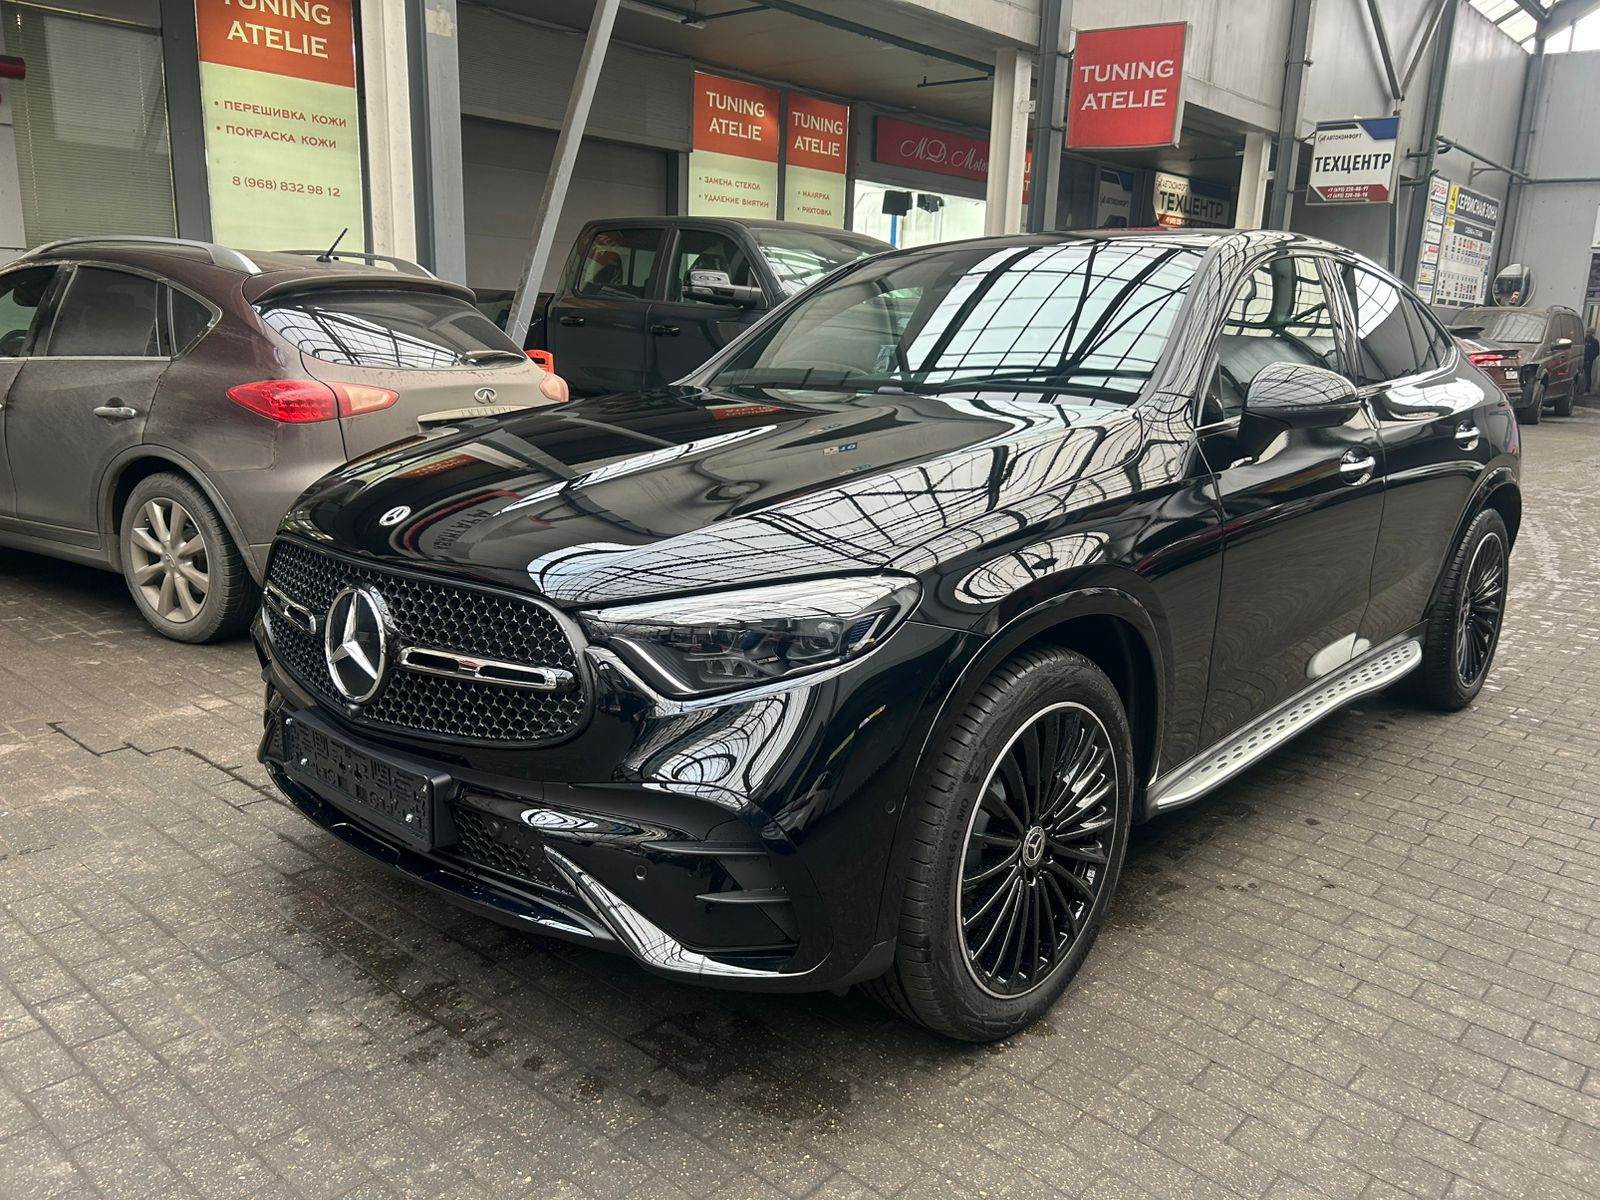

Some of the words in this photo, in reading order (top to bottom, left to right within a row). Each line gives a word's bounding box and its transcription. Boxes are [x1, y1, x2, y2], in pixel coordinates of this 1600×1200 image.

[224, 0, 331, 25] UNING
[226, 20, 329, 59] ATELIE
[1079, 59, 1174, 83] TUNING
[705, 91, 765, 118] TUNING
[1080, 88, 1167, 111] ATELIE
[224, 100, 306, 122] ПЕРЕШИВКА
[312, 113, 347, 128] КОЖИ
[792, 111, 844, 135] TUNING
[226, 125, 296, 144] ПОКРАСКА
[301, 135, 337, 149] КОЖИ
[708, 117, 762, 142] ATELIE
[794, 135, 841, 157] ATELIE
[951, 147, 988, 173] Moto
[1314, 152, 1392, 175] ТЕХЦЕНТР
[232, 176, 241, 186] 8
[244, 176, 277, 191] (968)
[280, 182, 304, 193] 832
[307, 185, 323, 196] 98
[328, 187, 341, 197] 12
[704, 176, 733, 187] ЗАМЕНА
[734, 180, 761, 190] СТЕКОЛ
[704, 193, 739, 206] УДАЛЕНИЕ
[741, 198, 769, 209] ВМЯТИН
[801, 206, 832, 217] РИХТОВКА
[1160, 190, 1224, 219] ТЕХЦЕНТР
[956, 798, 969, 822] MO
